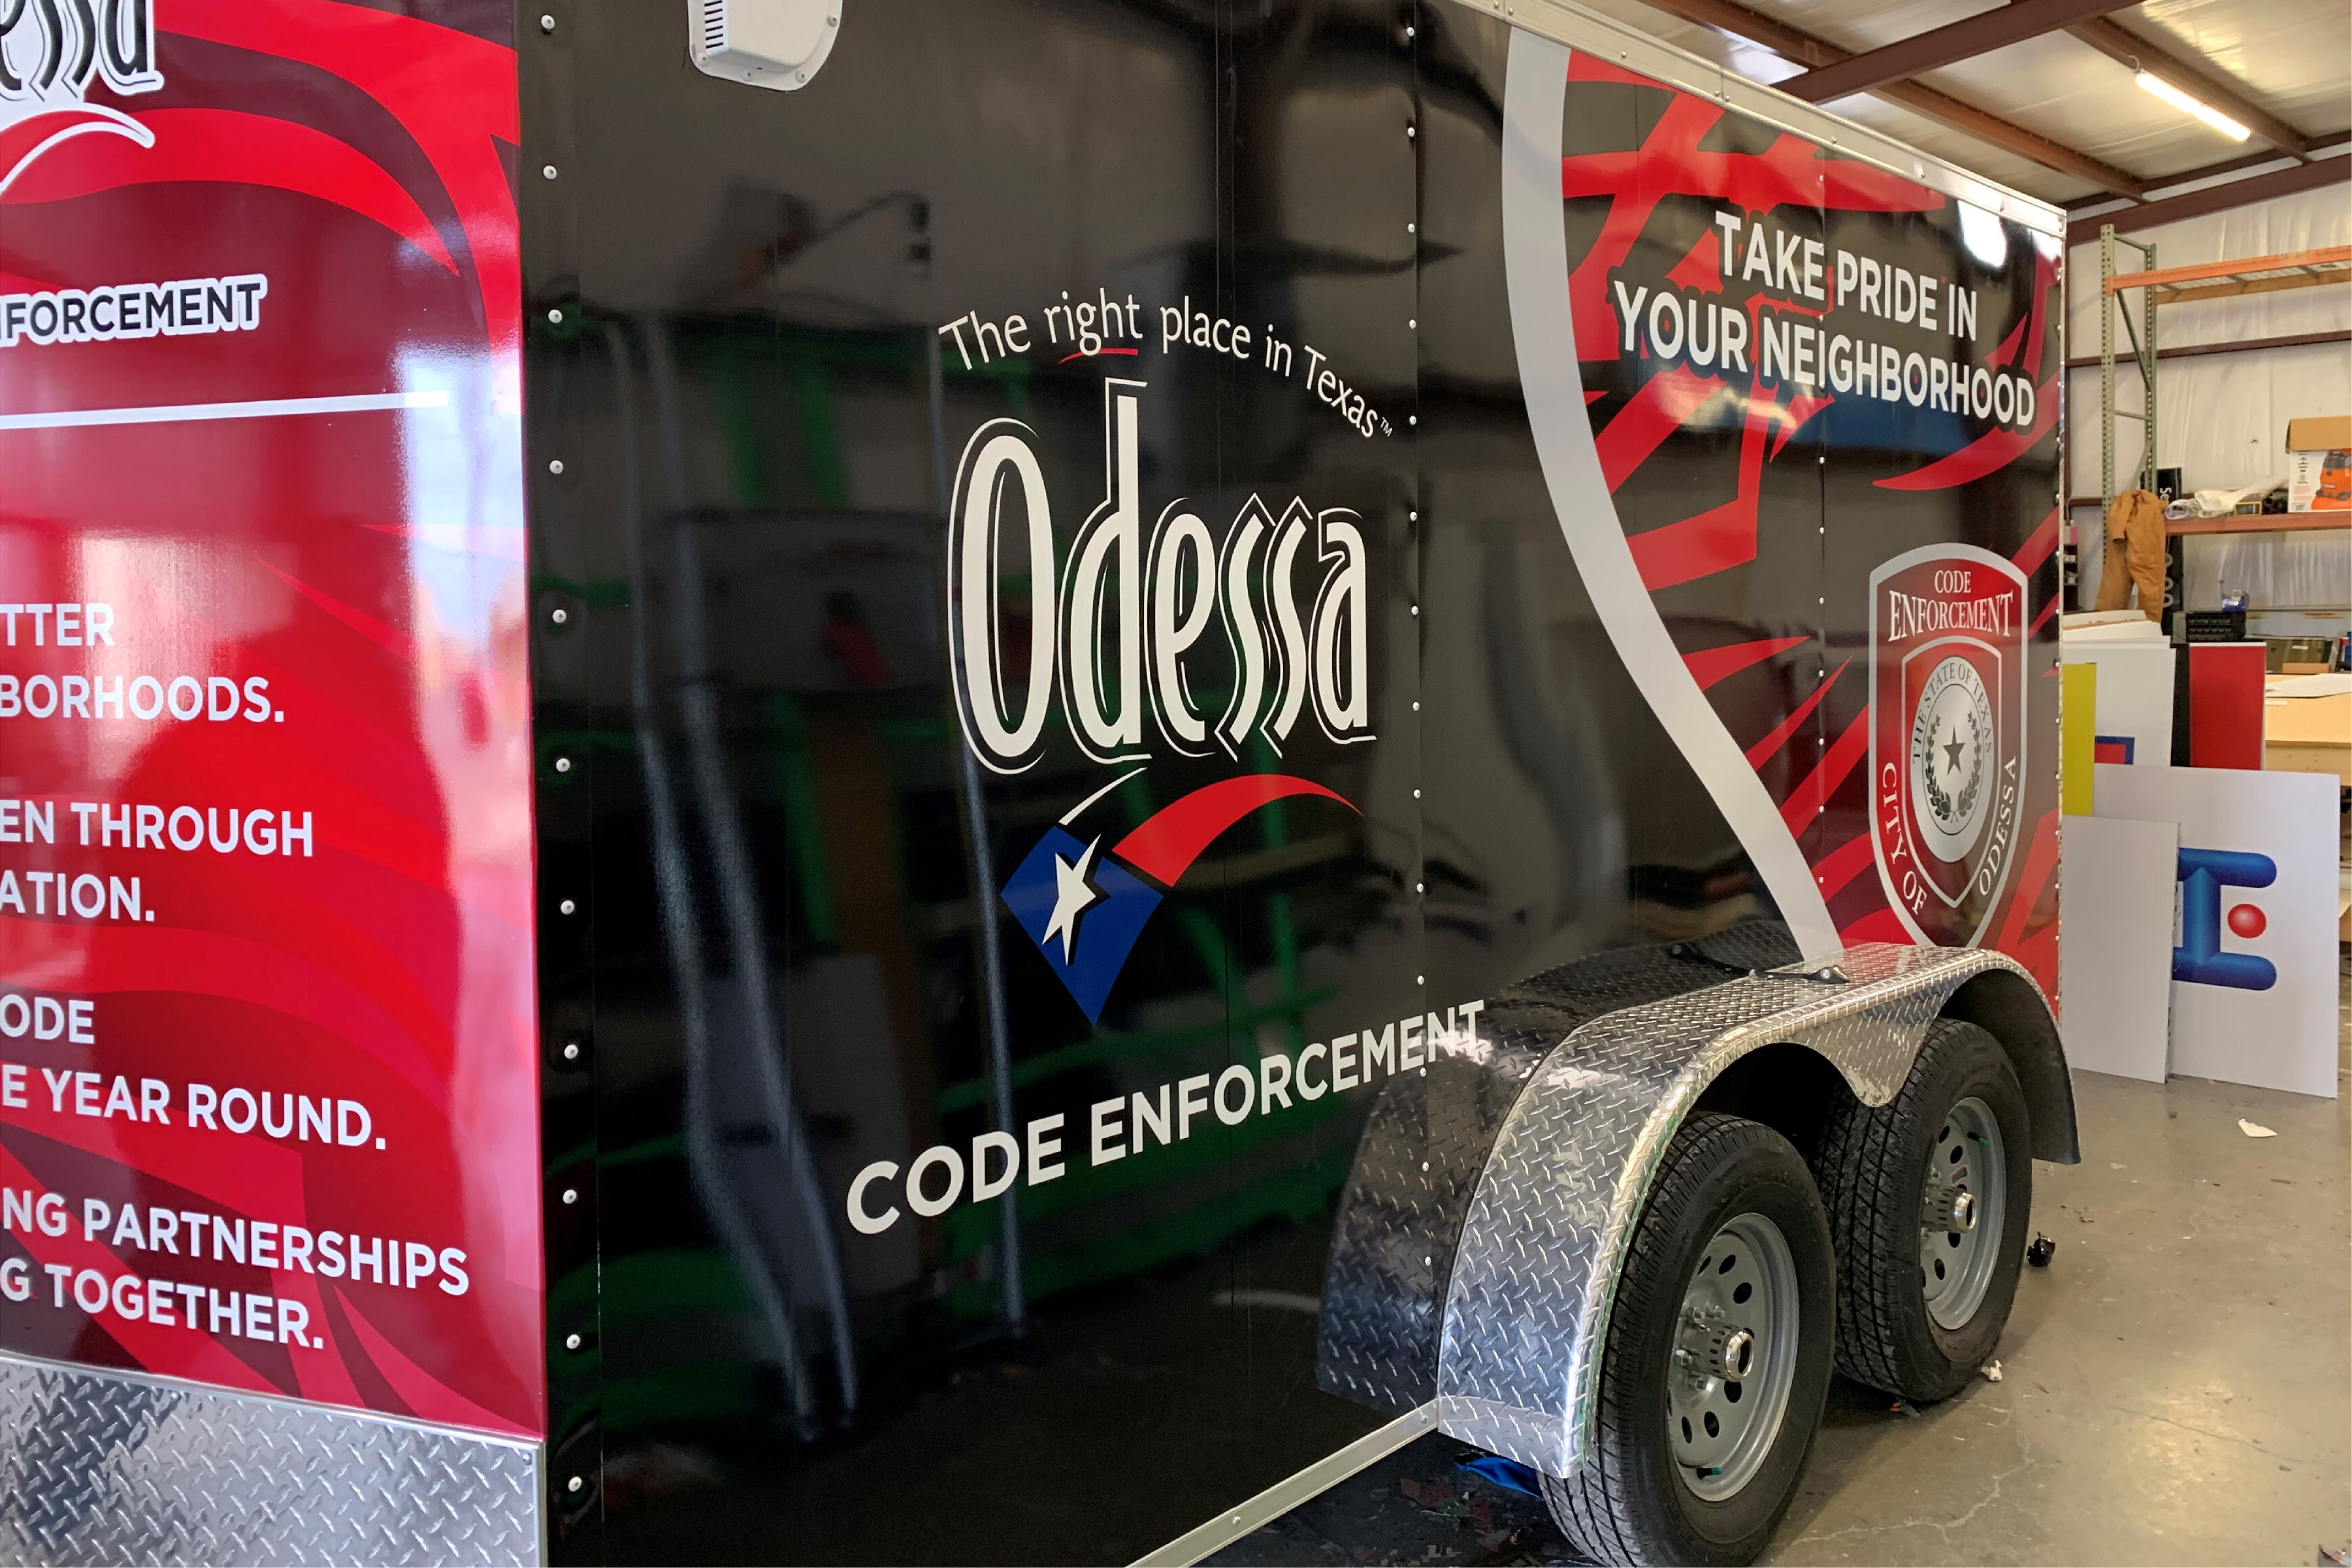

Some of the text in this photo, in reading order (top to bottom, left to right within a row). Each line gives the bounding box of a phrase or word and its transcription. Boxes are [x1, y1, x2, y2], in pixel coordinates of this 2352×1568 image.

[0, 282, 261, 340] FORCEMENT
[1716, 210, 1978, 341] TAKE PRIDE IN
[939, 310, 1031, 370] The
[1043, 287, 1143, 356] right
[1160, 295, 1252, 360] place
[1266, 324, 1292, 377] in
[1614, 280, 2035, 427] YOUR NEIGHBORHOOD
[947, 377, 1377, 775] Odessa
[1888, 590, 2014, 642] ENFORCEMENT
[1935, 570, 1972, 594] CODE
[1913, 662, 1992, 764] THE STATE OF TEXAS
[0, 799, 314, 857] EN THROUGH
[1882, 755, 2017, 915] CITY OF ODESSA
[0, 870, 155, 922] ATION.
[0, 994, 95, 1044] ODE
[2, 1064, 387, 1151] E YEAR ROUND.
[845, 999, 1484, 1235] CODE ENFORCEMENT
[3, 1186, 470, 1297] NG PARTNERSHIPS
[44, 1264, 325, 1350] TOGETHER.
